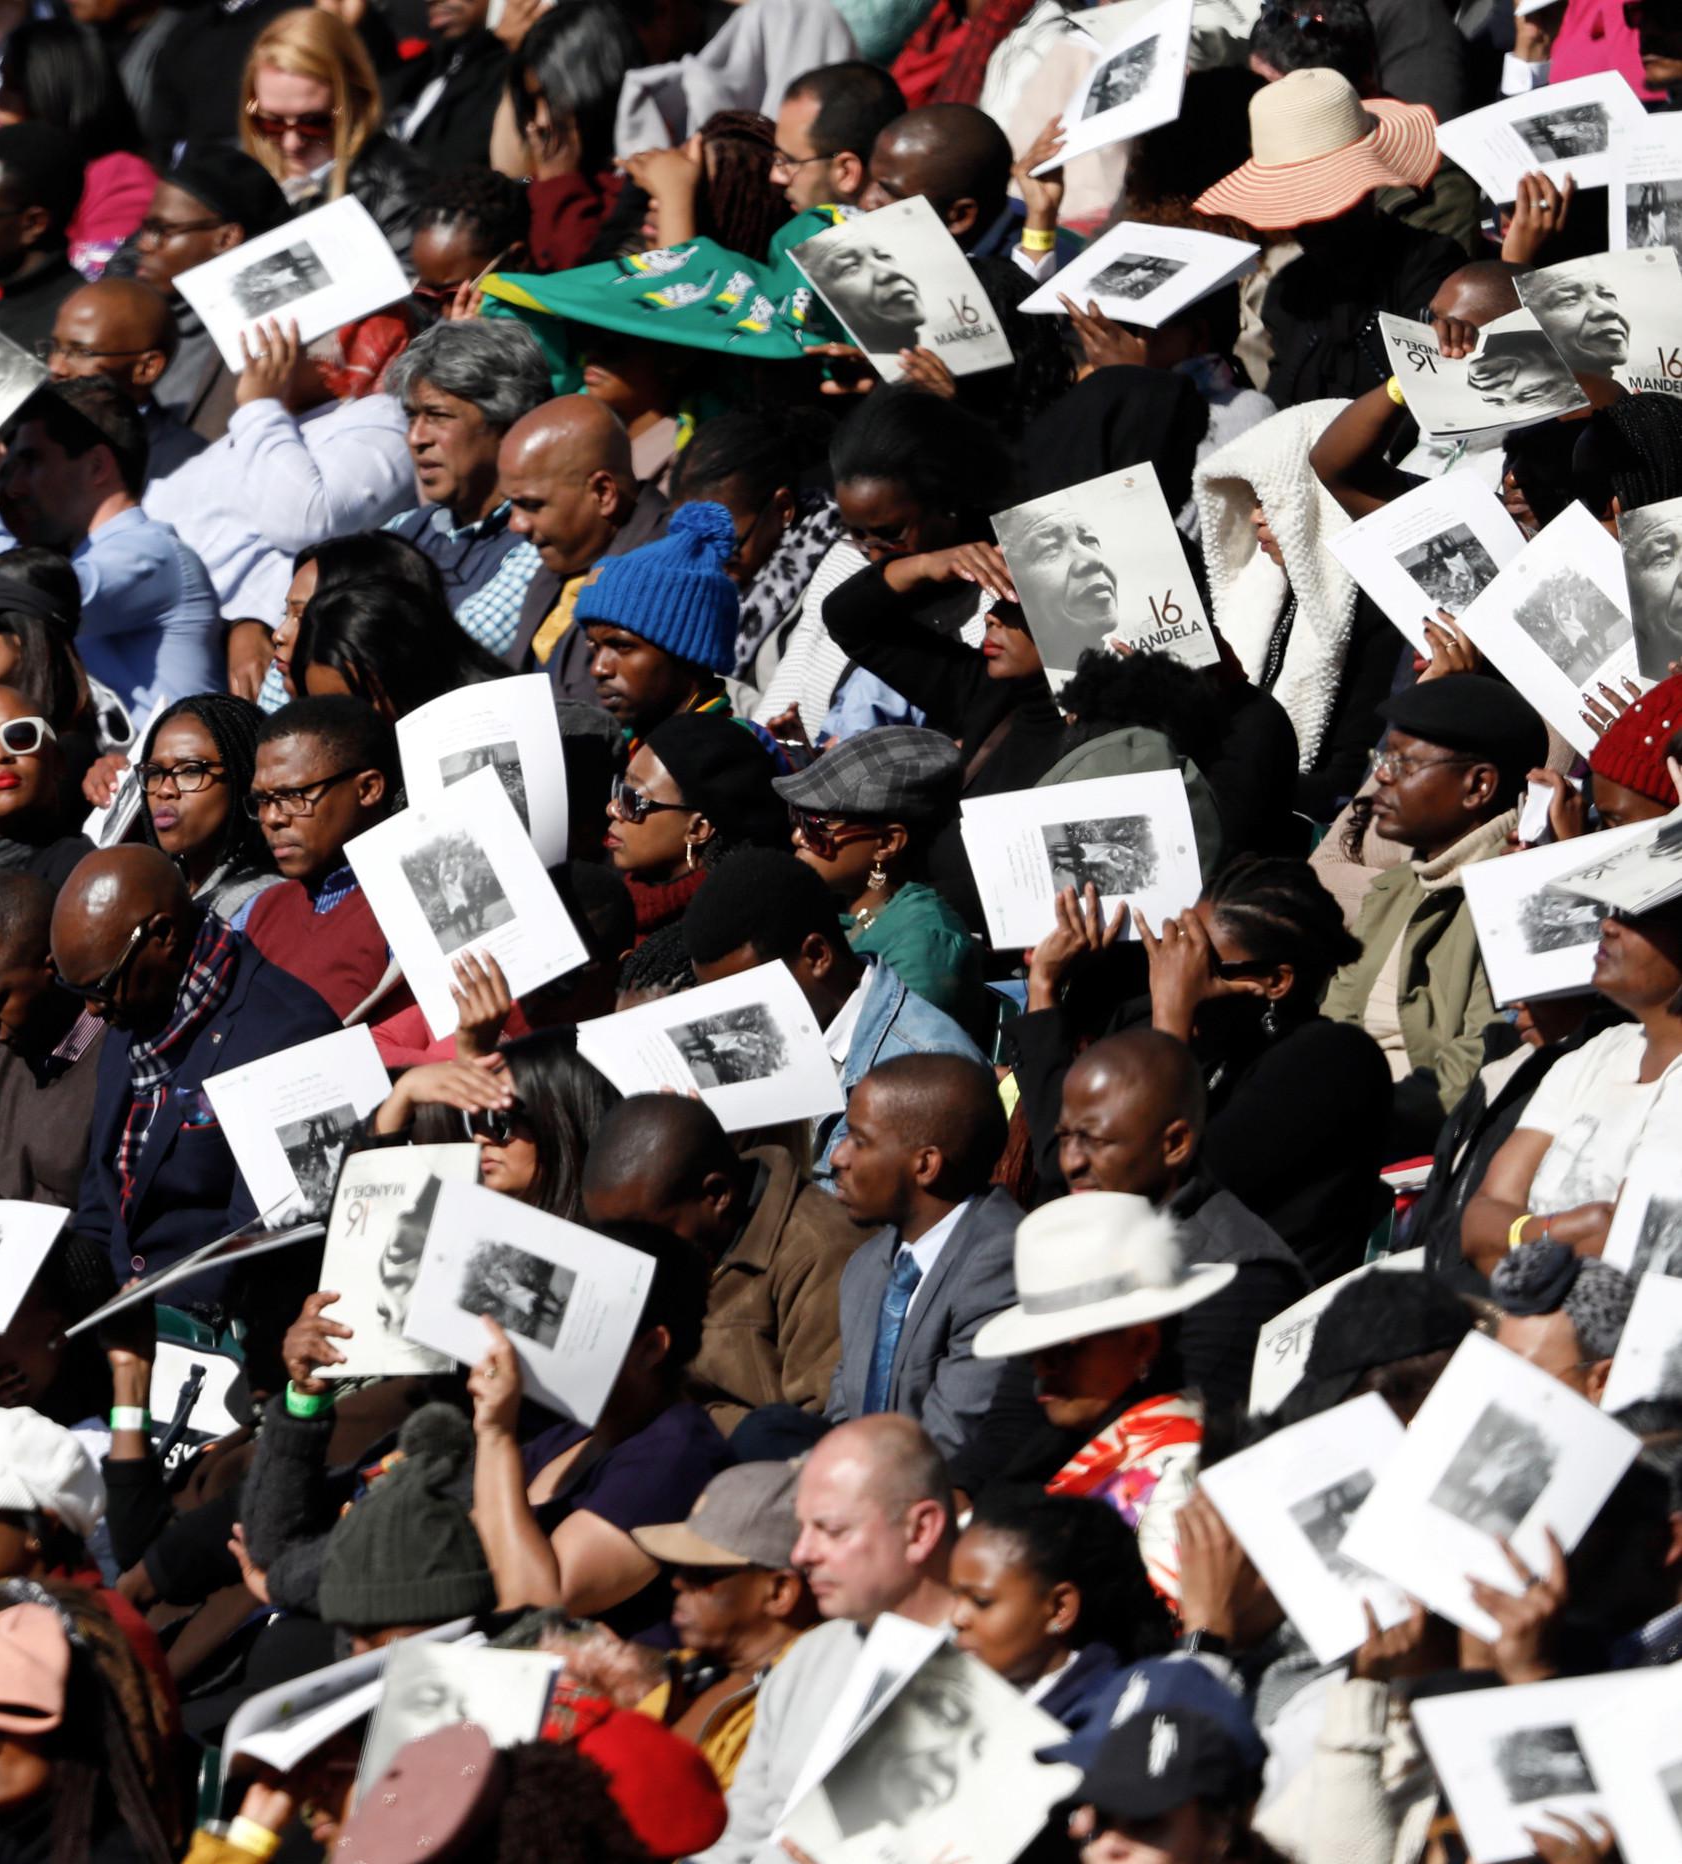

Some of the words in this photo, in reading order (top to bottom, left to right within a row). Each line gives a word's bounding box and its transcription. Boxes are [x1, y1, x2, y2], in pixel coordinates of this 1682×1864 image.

[948, 294, 980, 326] 16
[934, 324, 996, 346] MANDELA
[1407, 350, 1438, 374] 16
[1658, 346, 1682, 379] 16
[1149, 589, 1183, 628] 16
[344, 1199, 370, 1238] 16
[1275, 1331, 1302, 1365] 16
